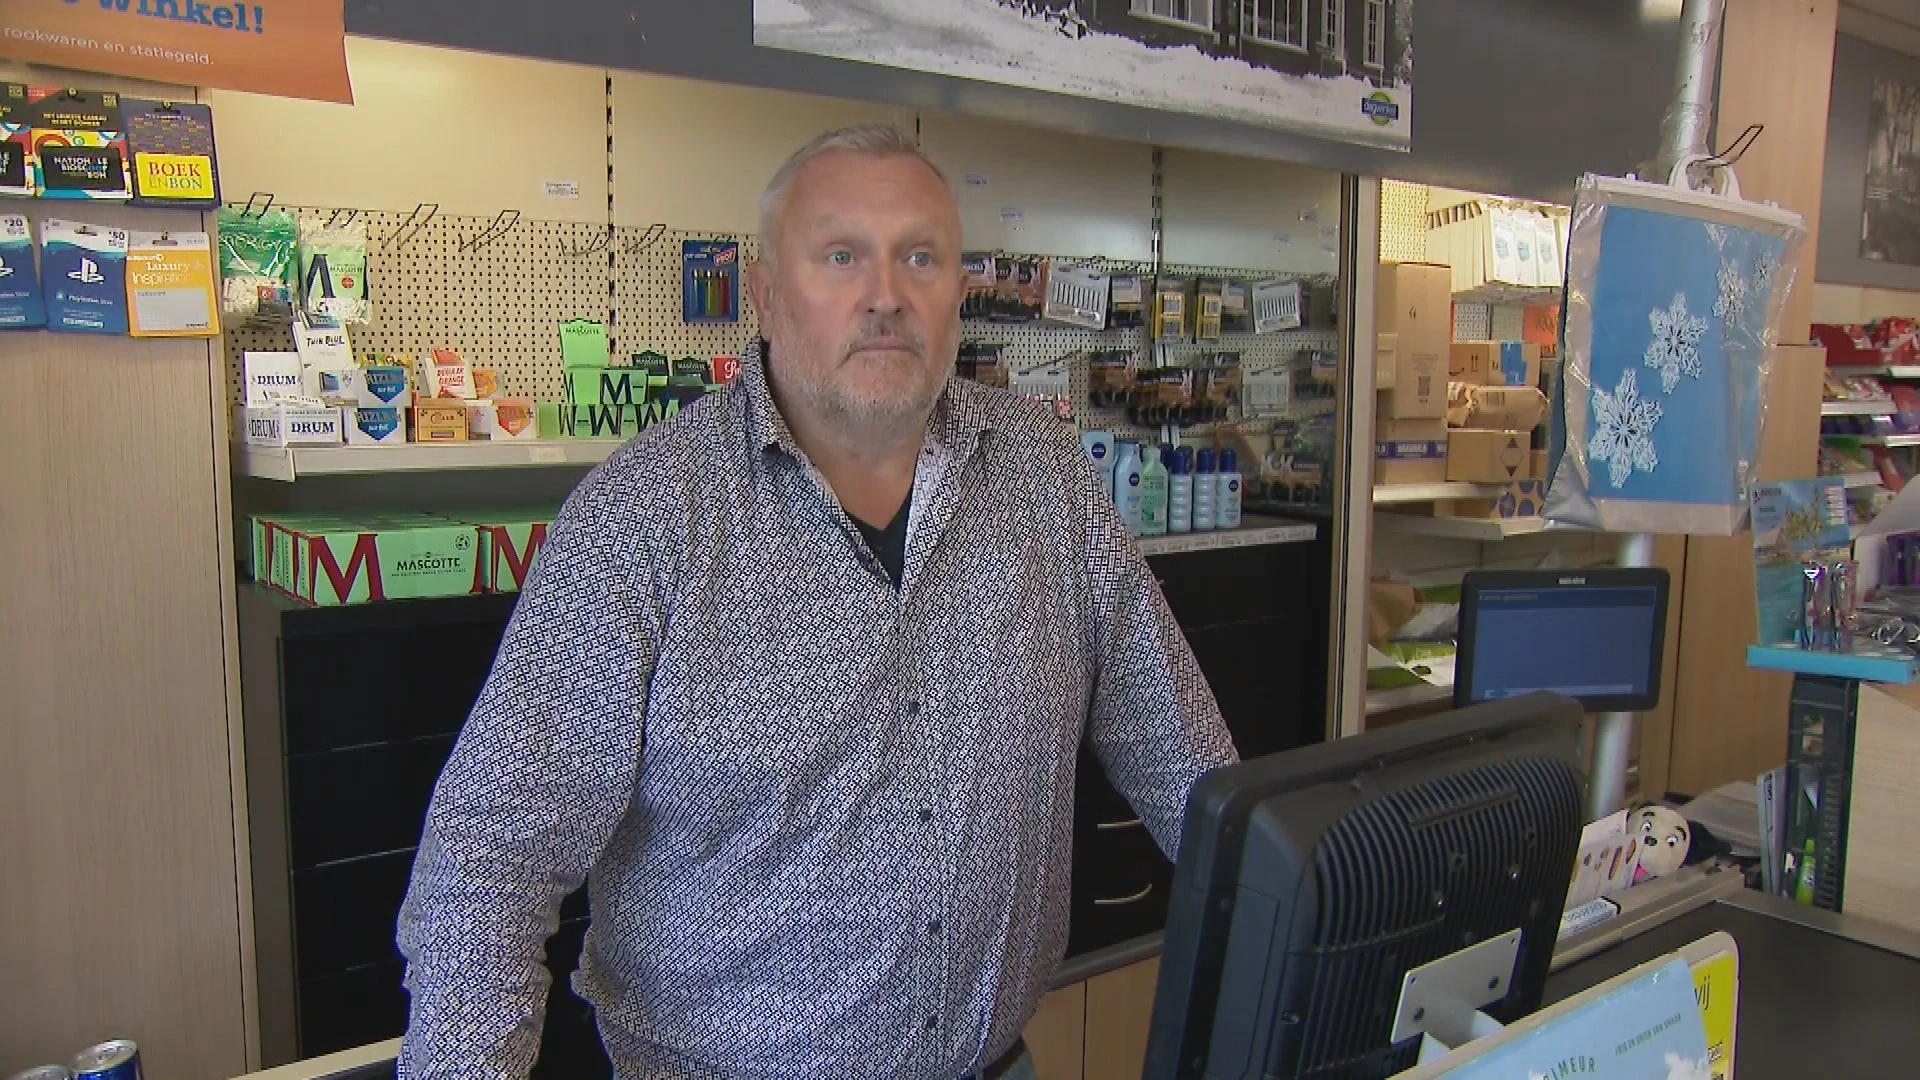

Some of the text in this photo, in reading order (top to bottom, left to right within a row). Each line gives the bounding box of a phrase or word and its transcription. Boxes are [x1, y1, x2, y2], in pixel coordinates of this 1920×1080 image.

[4, 26, 214, 65] rookwaren en statiegeld.
[148, 162, 200, 177] BOEK
[149, 175, 202, 190] ENBON
[147, 262, 190, 272] Luxury
[257, 375, 296, 385] DRUM
[251, 419, 277, 439] DRUM
[291, 422, 334, 433] DRUM
[397, 557, 460, 571] MASCOTTE
